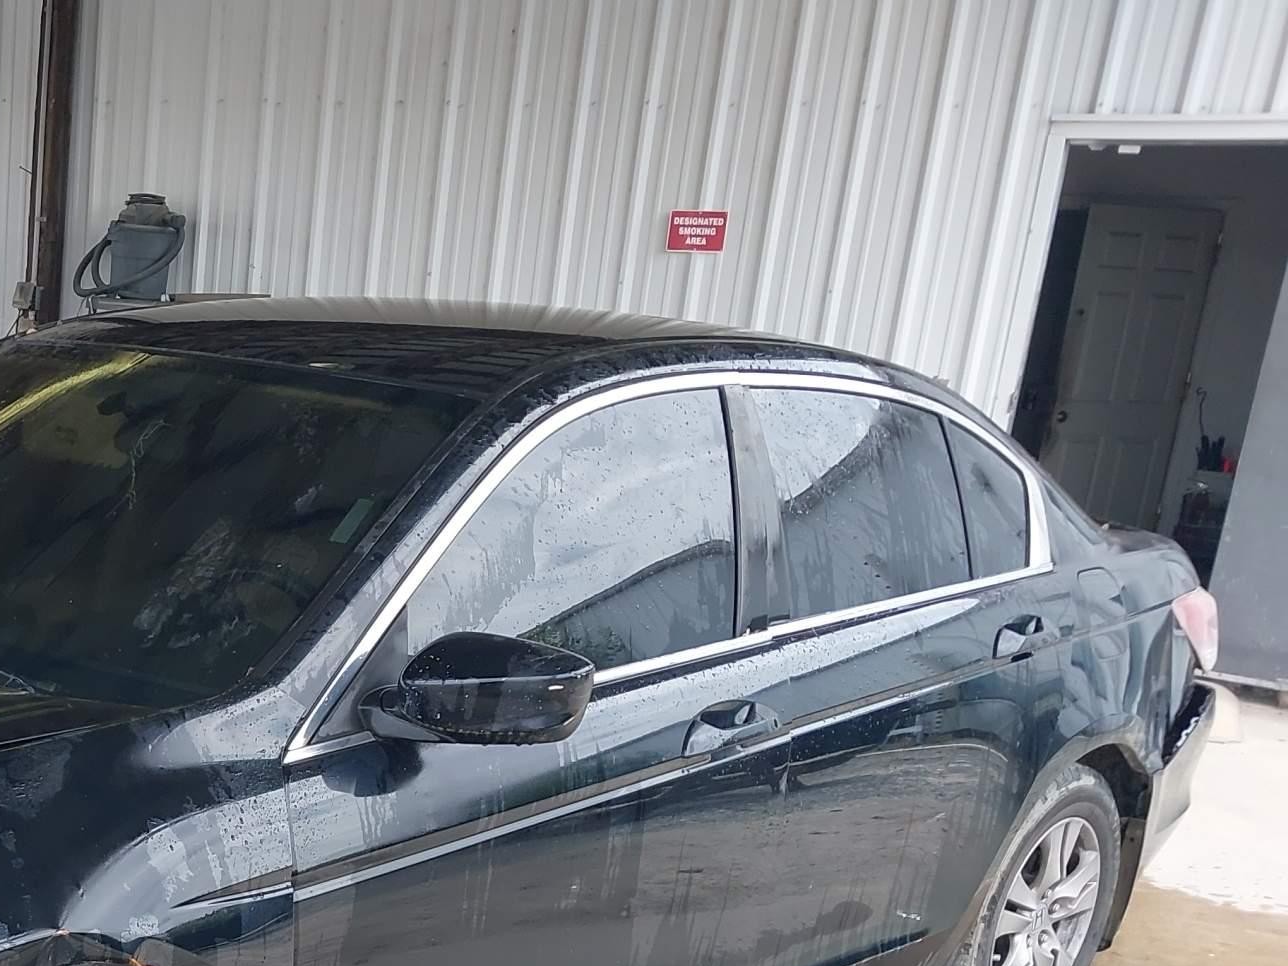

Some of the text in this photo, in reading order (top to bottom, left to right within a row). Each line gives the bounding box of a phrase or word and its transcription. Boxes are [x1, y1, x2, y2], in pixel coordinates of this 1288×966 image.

[674, 217, 724, 225] DESIGNATED
[678, 227, 716, 235] SMOKING
[685, 237, 706, 245] AREA
